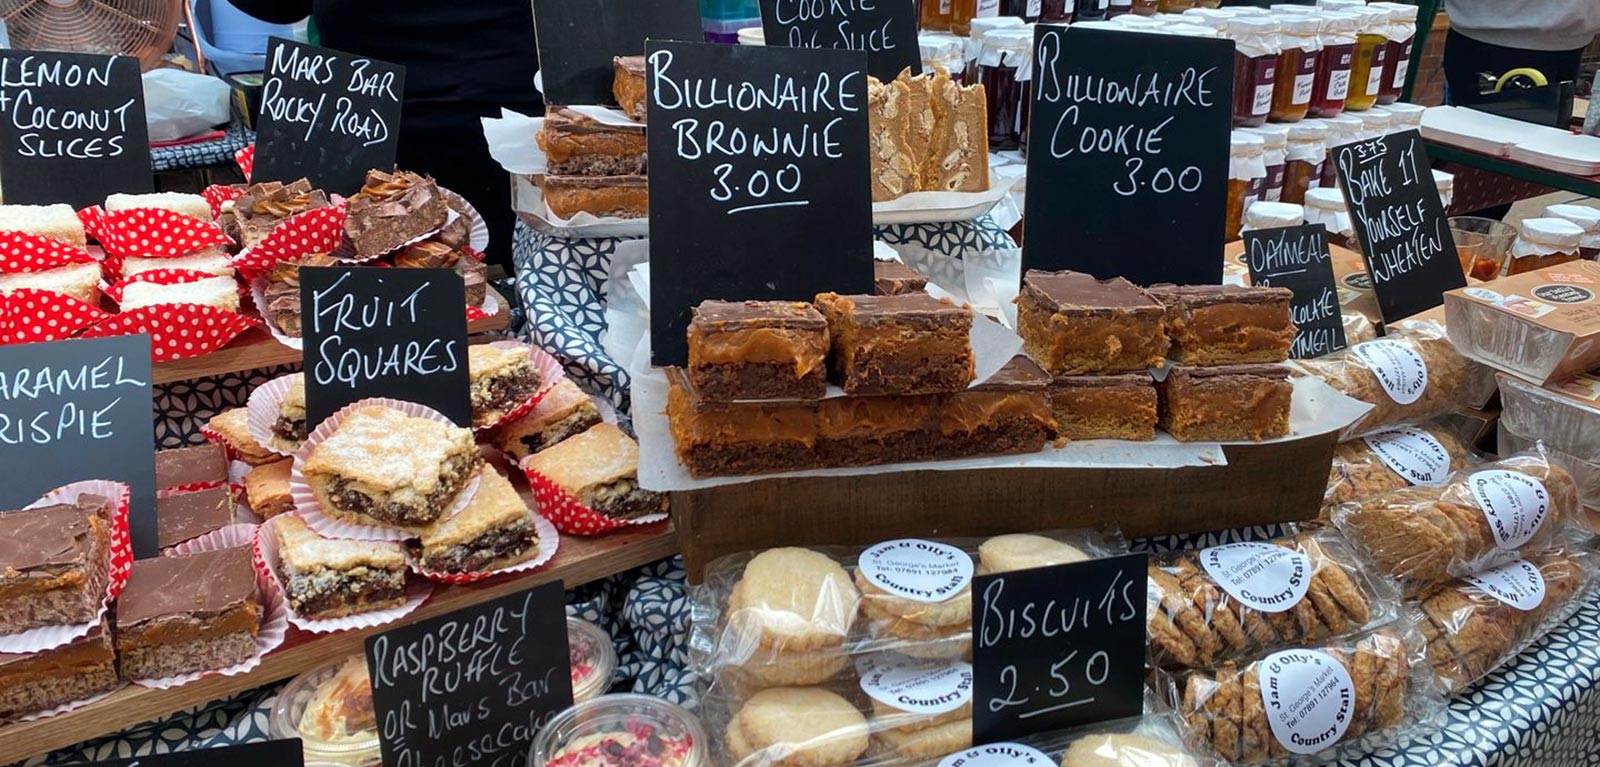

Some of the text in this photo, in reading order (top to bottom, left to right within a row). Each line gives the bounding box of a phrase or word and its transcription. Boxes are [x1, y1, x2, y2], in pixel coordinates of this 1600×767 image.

[789, 26, 822, 48] PE
[1, 55, 118, 87] LEMON
[271, 44, 398, 102] MARS BAR
[648, 50, 860, 113] BILLIONAIRE
[1038, 32, 1218, 107] BILLIONAIRE
[13, 89, 135, 132] COCONUT
[260, 78, 388, 146] ROCKY ROAD
[1050, 105, 1175, 158] COOKIE
[18, 133, 123, 158] SLICES
[672, 117, 843, 160] BROWNIE
[1354, 134, 1388, 158] 3.75
[710, 164, 802, 201] 3.00
[1113, 158, 1202, 195] 3.00
[1340, 148, 1392, 206] BAKE
[1357, 198, 1426, 258] YOURSELF
[1368, 217, 1442, 284] WHEATEN
[1250, 230, 1330, 273] OATMEAL
[313, 272, 430, 332] FRUIT
[314, 335, 457, 388] SQUARES
[1376, 367, 1394, 391] Stall
[1410, 469, 1432, 481] Stall
[870, 545, 895, 558] Jam
[916, 543, 955, 560] Olly's
[1496, 520, 1510, 542] Stall
[876, 574, 963, 598] Country Stall
[1241, 556, 1303, 604] Country Stall
[1243, 563, 1264, 579] 07891
[1488, 584, 1518, 602] Stall
[1522, 565, 1540, 593] Olly's
[979, 569, 1138, 649] BISCUITS
[374, 592, 532, 688] RASPBERRY
[422, 636, 524, 703] RUFFLE
[988, 650, 1110, 712] 2.50
[1269, 654, 1321, 710] Jam & Olly's
[1288, 686, 1316, 712] George's
[1313, 666, 1334, 686] Market
[384, 665, 559, 740] OR Mars Bar
[898, 690, 961, 706] Country
[1286, 676, 1340, 729] Tel: 07891 127964
[1291, 688, 1349, 746] Country Stall
[985, 748, 1036, 764] Olly's
